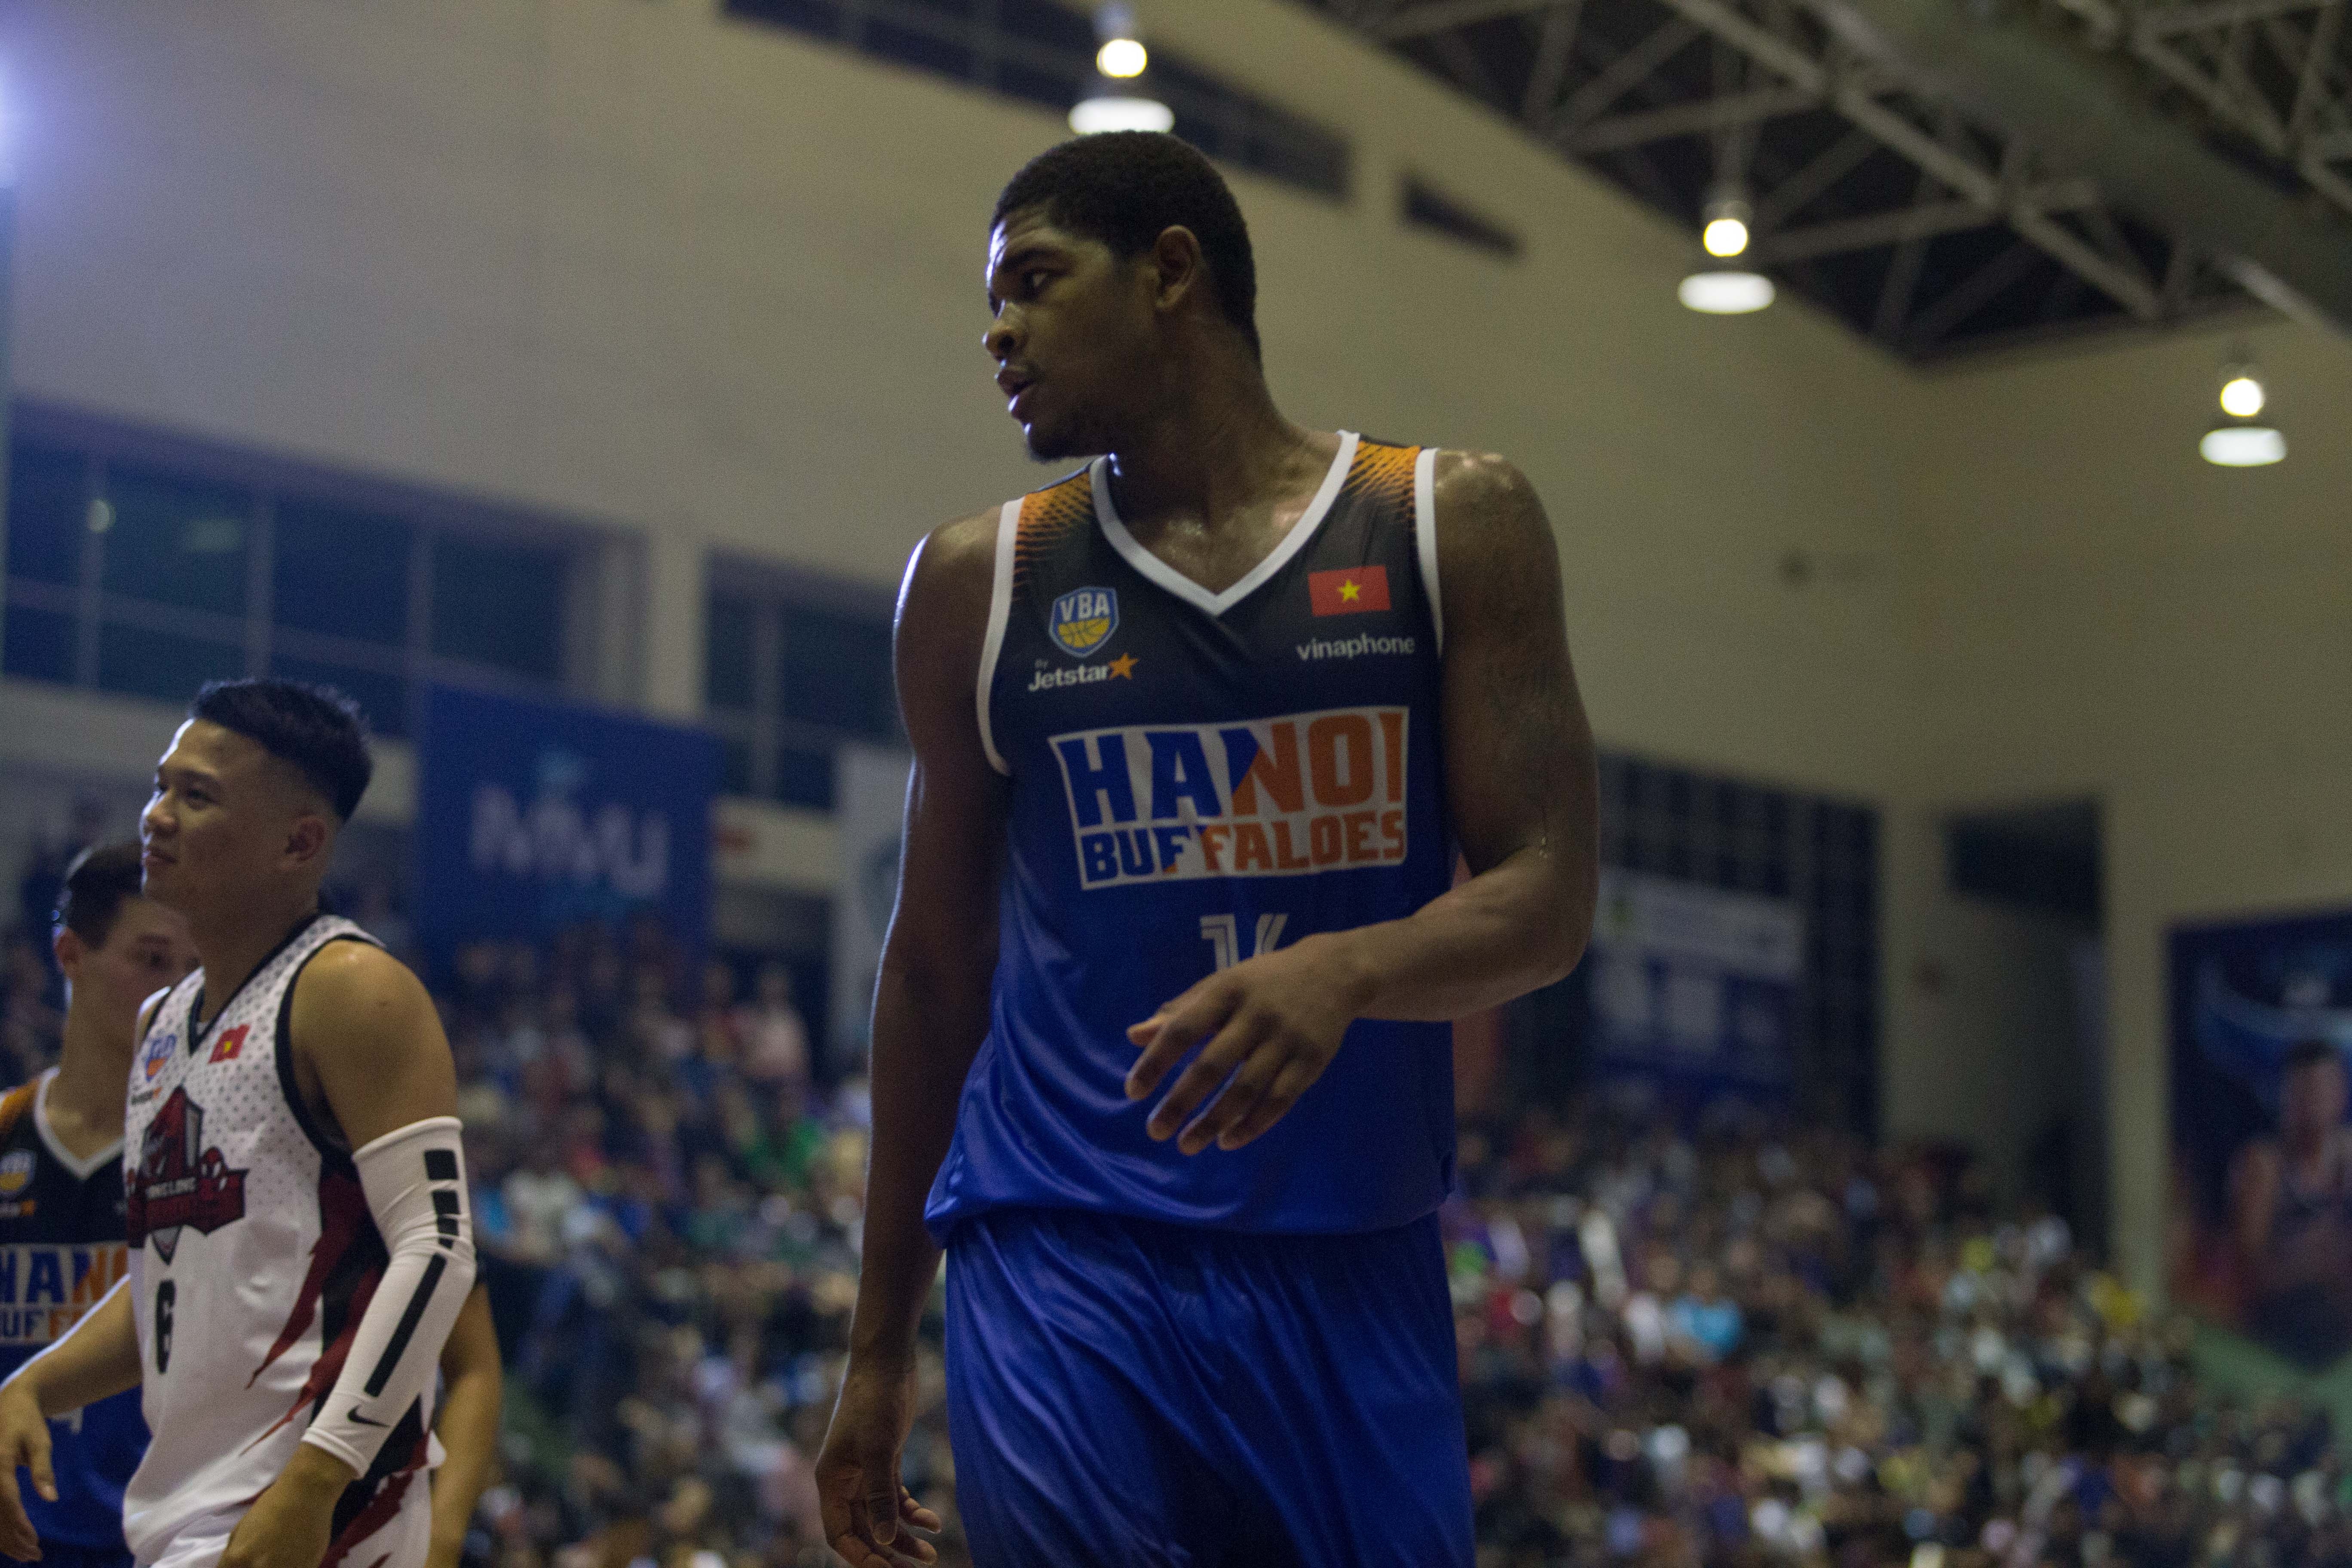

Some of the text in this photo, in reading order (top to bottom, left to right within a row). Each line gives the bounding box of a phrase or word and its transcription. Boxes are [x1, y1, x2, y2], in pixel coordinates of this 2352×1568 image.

[1058, 592, 1110, 622] VBA
[1295, 632, 1415, 661] vinaphone
[1028, 664, 1110, 692] Jetstar
[1056, 711, 1404, 830] HANOI
[1080, 809, 1405, 884] BUFFALOES
